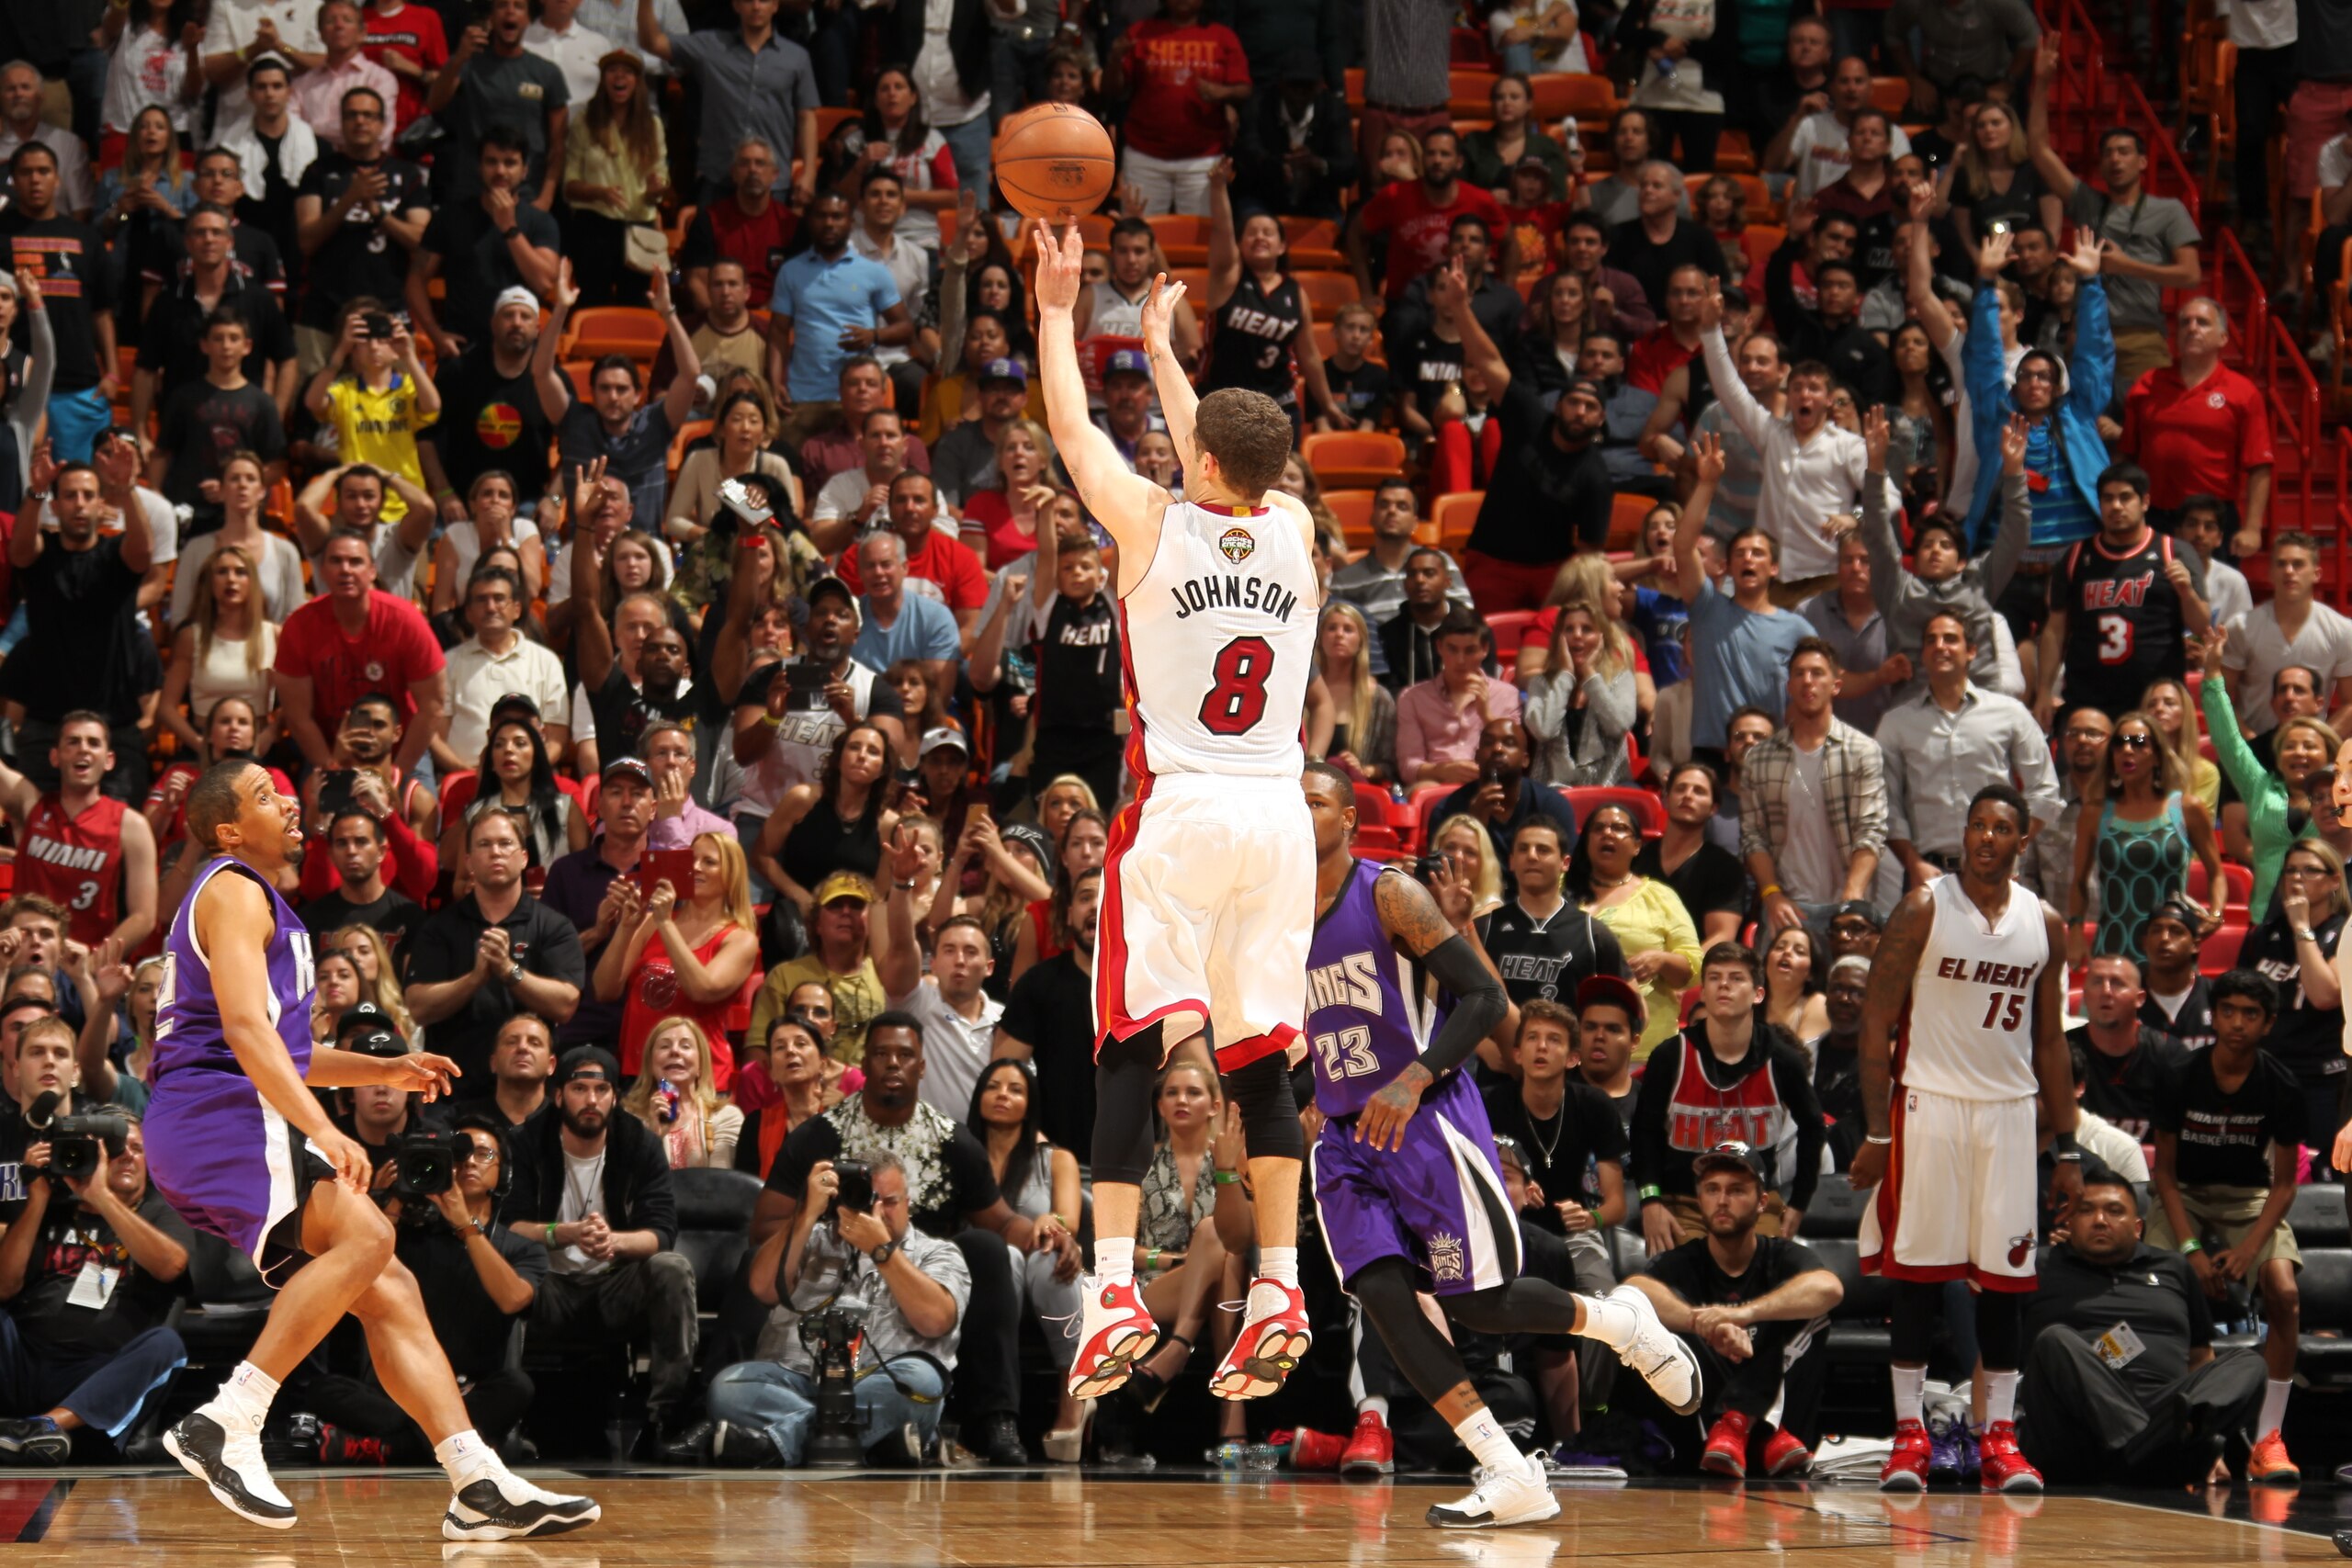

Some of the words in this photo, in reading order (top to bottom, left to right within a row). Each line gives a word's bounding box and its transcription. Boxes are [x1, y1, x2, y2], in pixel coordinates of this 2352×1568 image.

[1148, 39, 1218, 61] HEAT
[1227, 307, 1298, 342] HEAT
[1256, 345, 1281, 369] 3
[1419, 362, 1463, 381] MIA
[1170, 575, 1297, 624] JOHNSON
[2084, 570, 2154, 611] HEAT
[1059, 618, 1111, 646] HEAT
[2098, 615, 2135, 666] 3
[1097, 648, 1107, 674] 1
[1197, 635, 1277, 738] 8
[777, 714, 847, 750] HEAT
[26, 834, 108, 873] MIAMI
[72, 880, 99, 910] 3
[1306, 951, 1383, 1019] INGS
[1499, 952, 1574, 984] HEAT
[1938, 957, 1968, 981] EL
[1973, 961, 2039, 989] HEAT
[1981, 991, 2028, 1032] 15
[1314, 1025, 1381, 1083] 23
[1670, 1111, 1773, 1151] HEAT
[2181, 1128, 2258, 1147] BASKETBALL
[1431, 1252, 1461, 1273] KINGS
